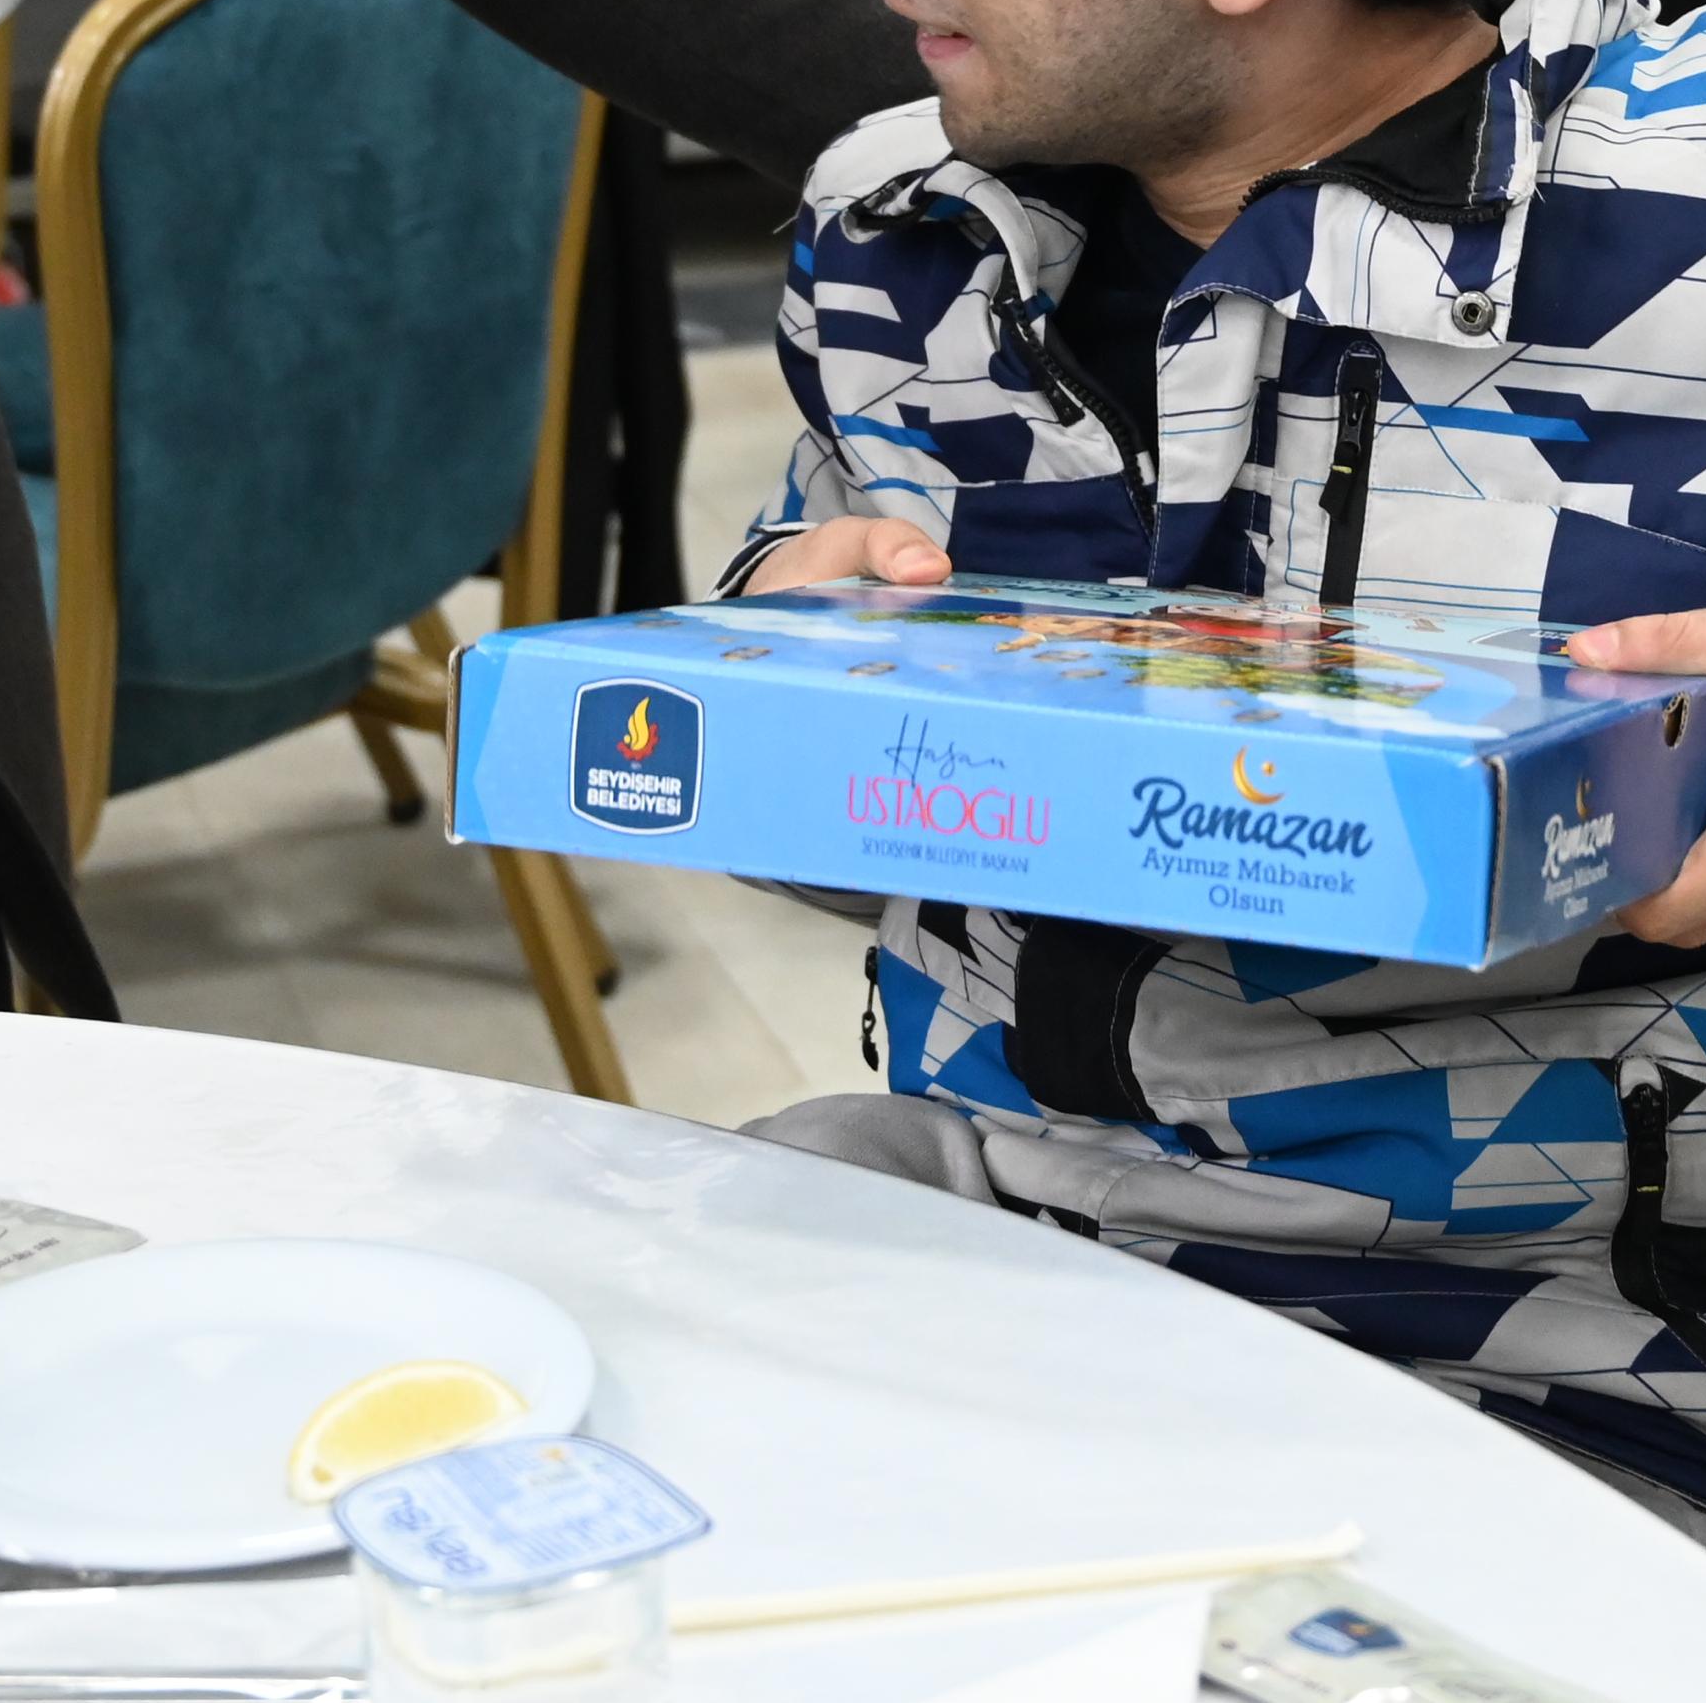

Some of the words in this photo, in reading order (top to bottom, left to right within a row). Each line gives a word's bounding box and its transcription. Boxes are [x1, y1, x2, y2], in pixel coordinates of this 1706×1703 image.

[588, 768, 682, 796] SEYDİŞEHİR
[586, 787, 682, 816] BELEDİYESİ
[1129, 776, 1374, 859] Ramazan
[1142, 846, 1230, 878] Ayımız
[1237, 857, 1356, 895] Mübarek
[1208, 884, 1285, 916] Olsun
